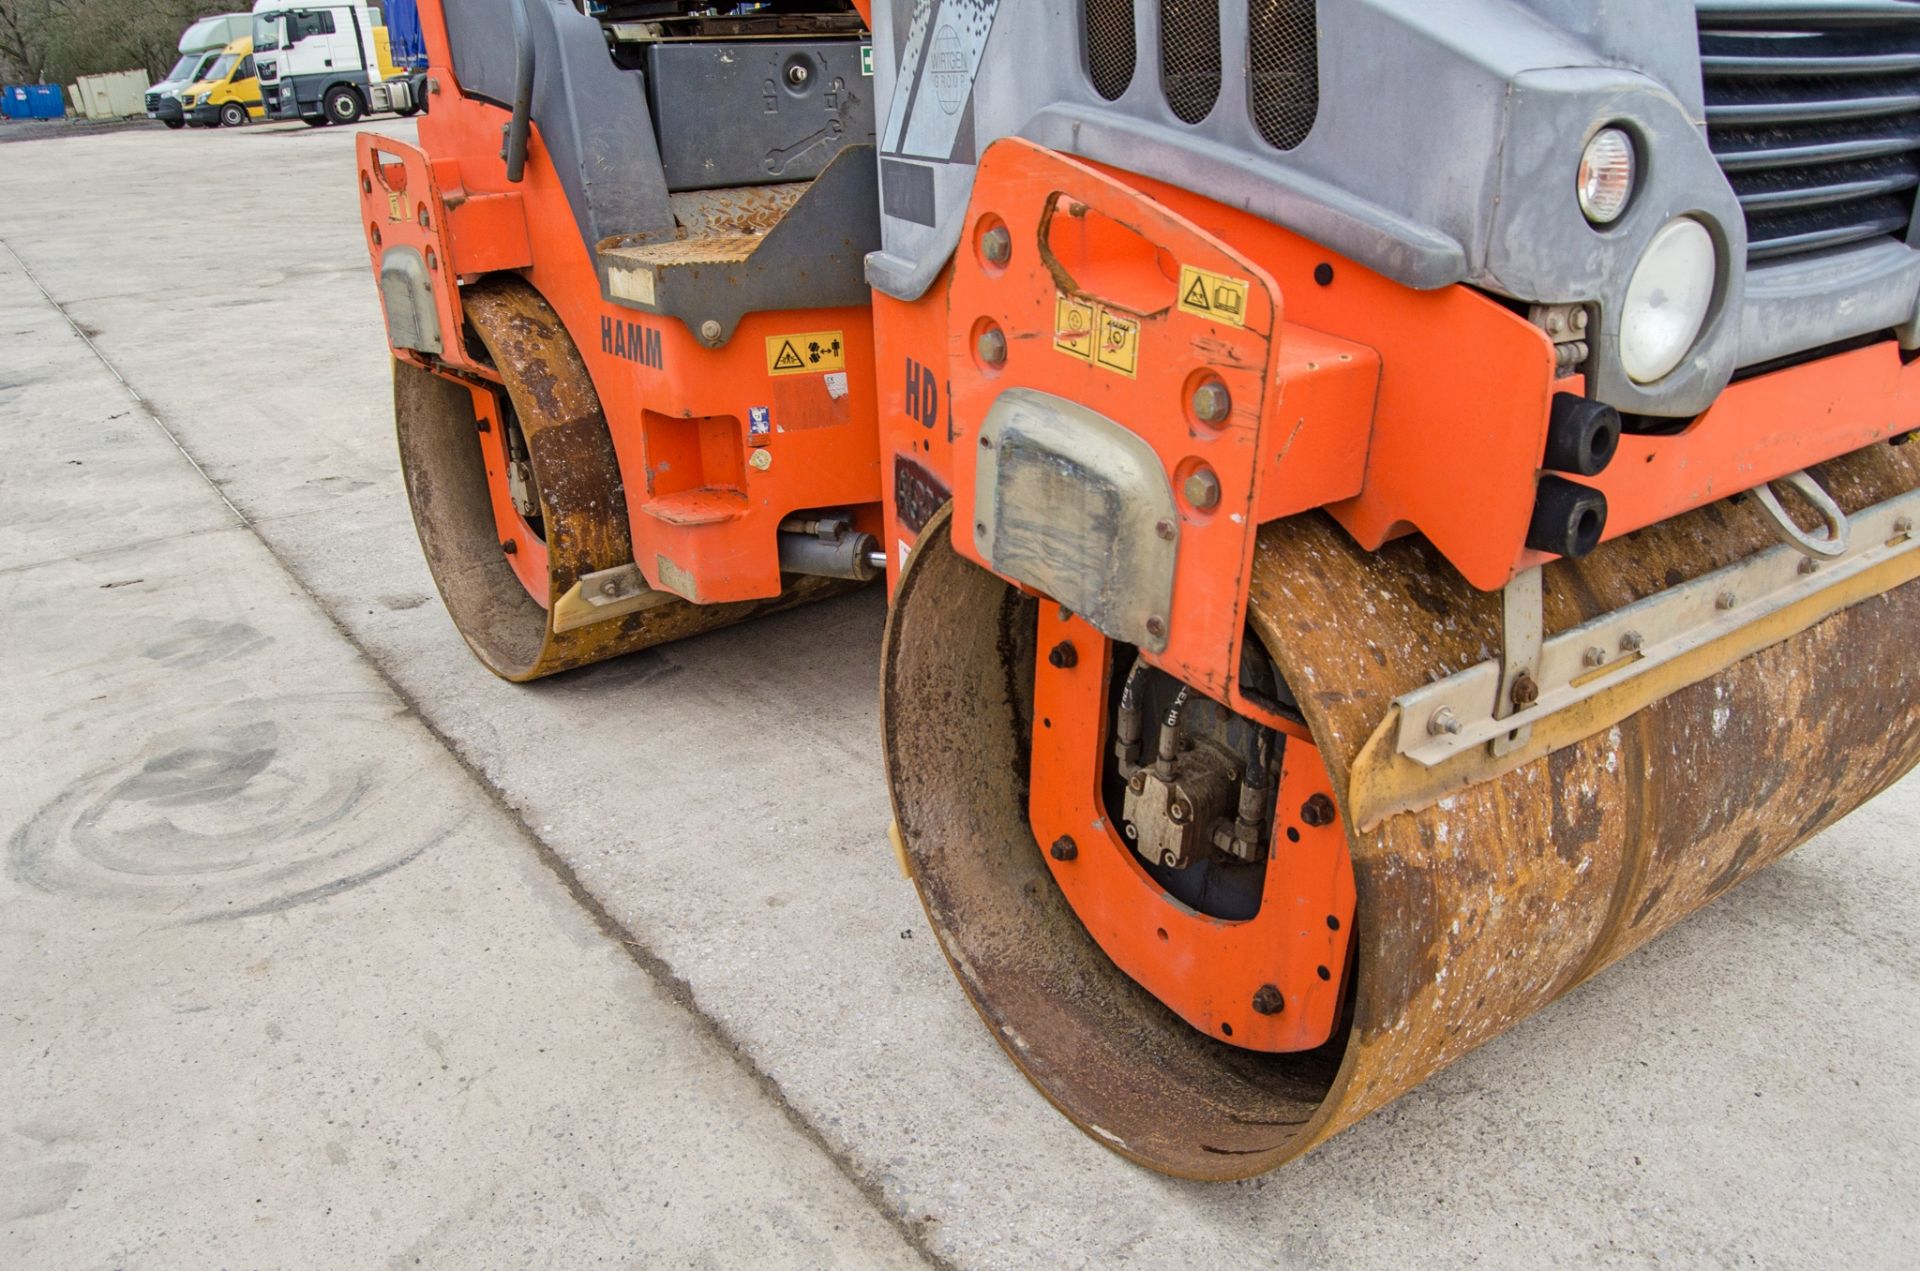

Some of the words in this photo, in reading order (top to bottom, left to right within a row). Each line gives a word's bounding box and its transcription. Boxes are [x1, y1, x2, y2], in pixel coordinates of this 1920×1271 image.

[931, 51, 968, 70] WIRTGEN
[934, 74, 966, 89] GROUP
[600, 315, 663, 370] HAMM
[905, 356, 938, 430] HD
[1167, 709, 1179, 727] HD
